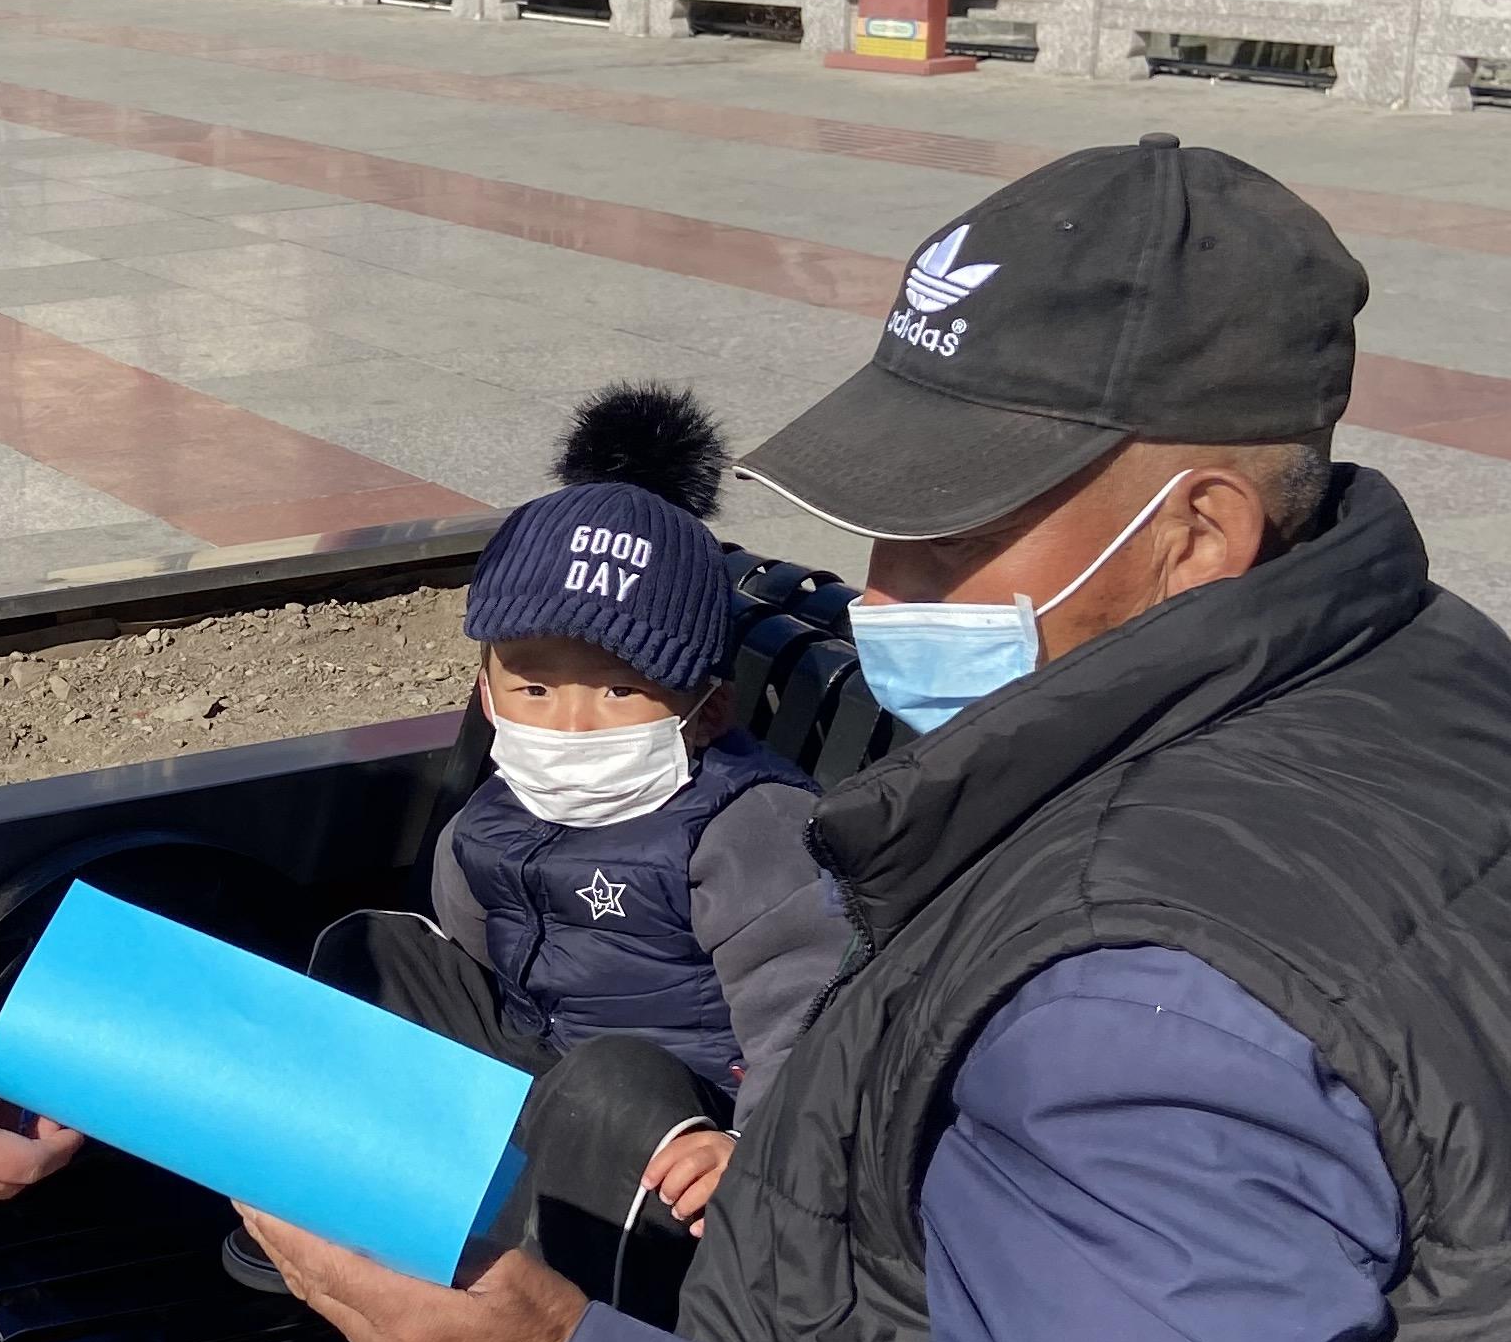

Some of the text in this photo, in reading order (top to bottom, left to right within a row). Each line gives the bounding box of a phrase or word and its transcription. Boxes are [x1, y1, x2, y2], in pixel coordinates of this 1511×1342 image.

[887, 308, 959, 357] adidas
[569, 524, 653, 569] GOOD
[564, 560, 640, 602] DAY
